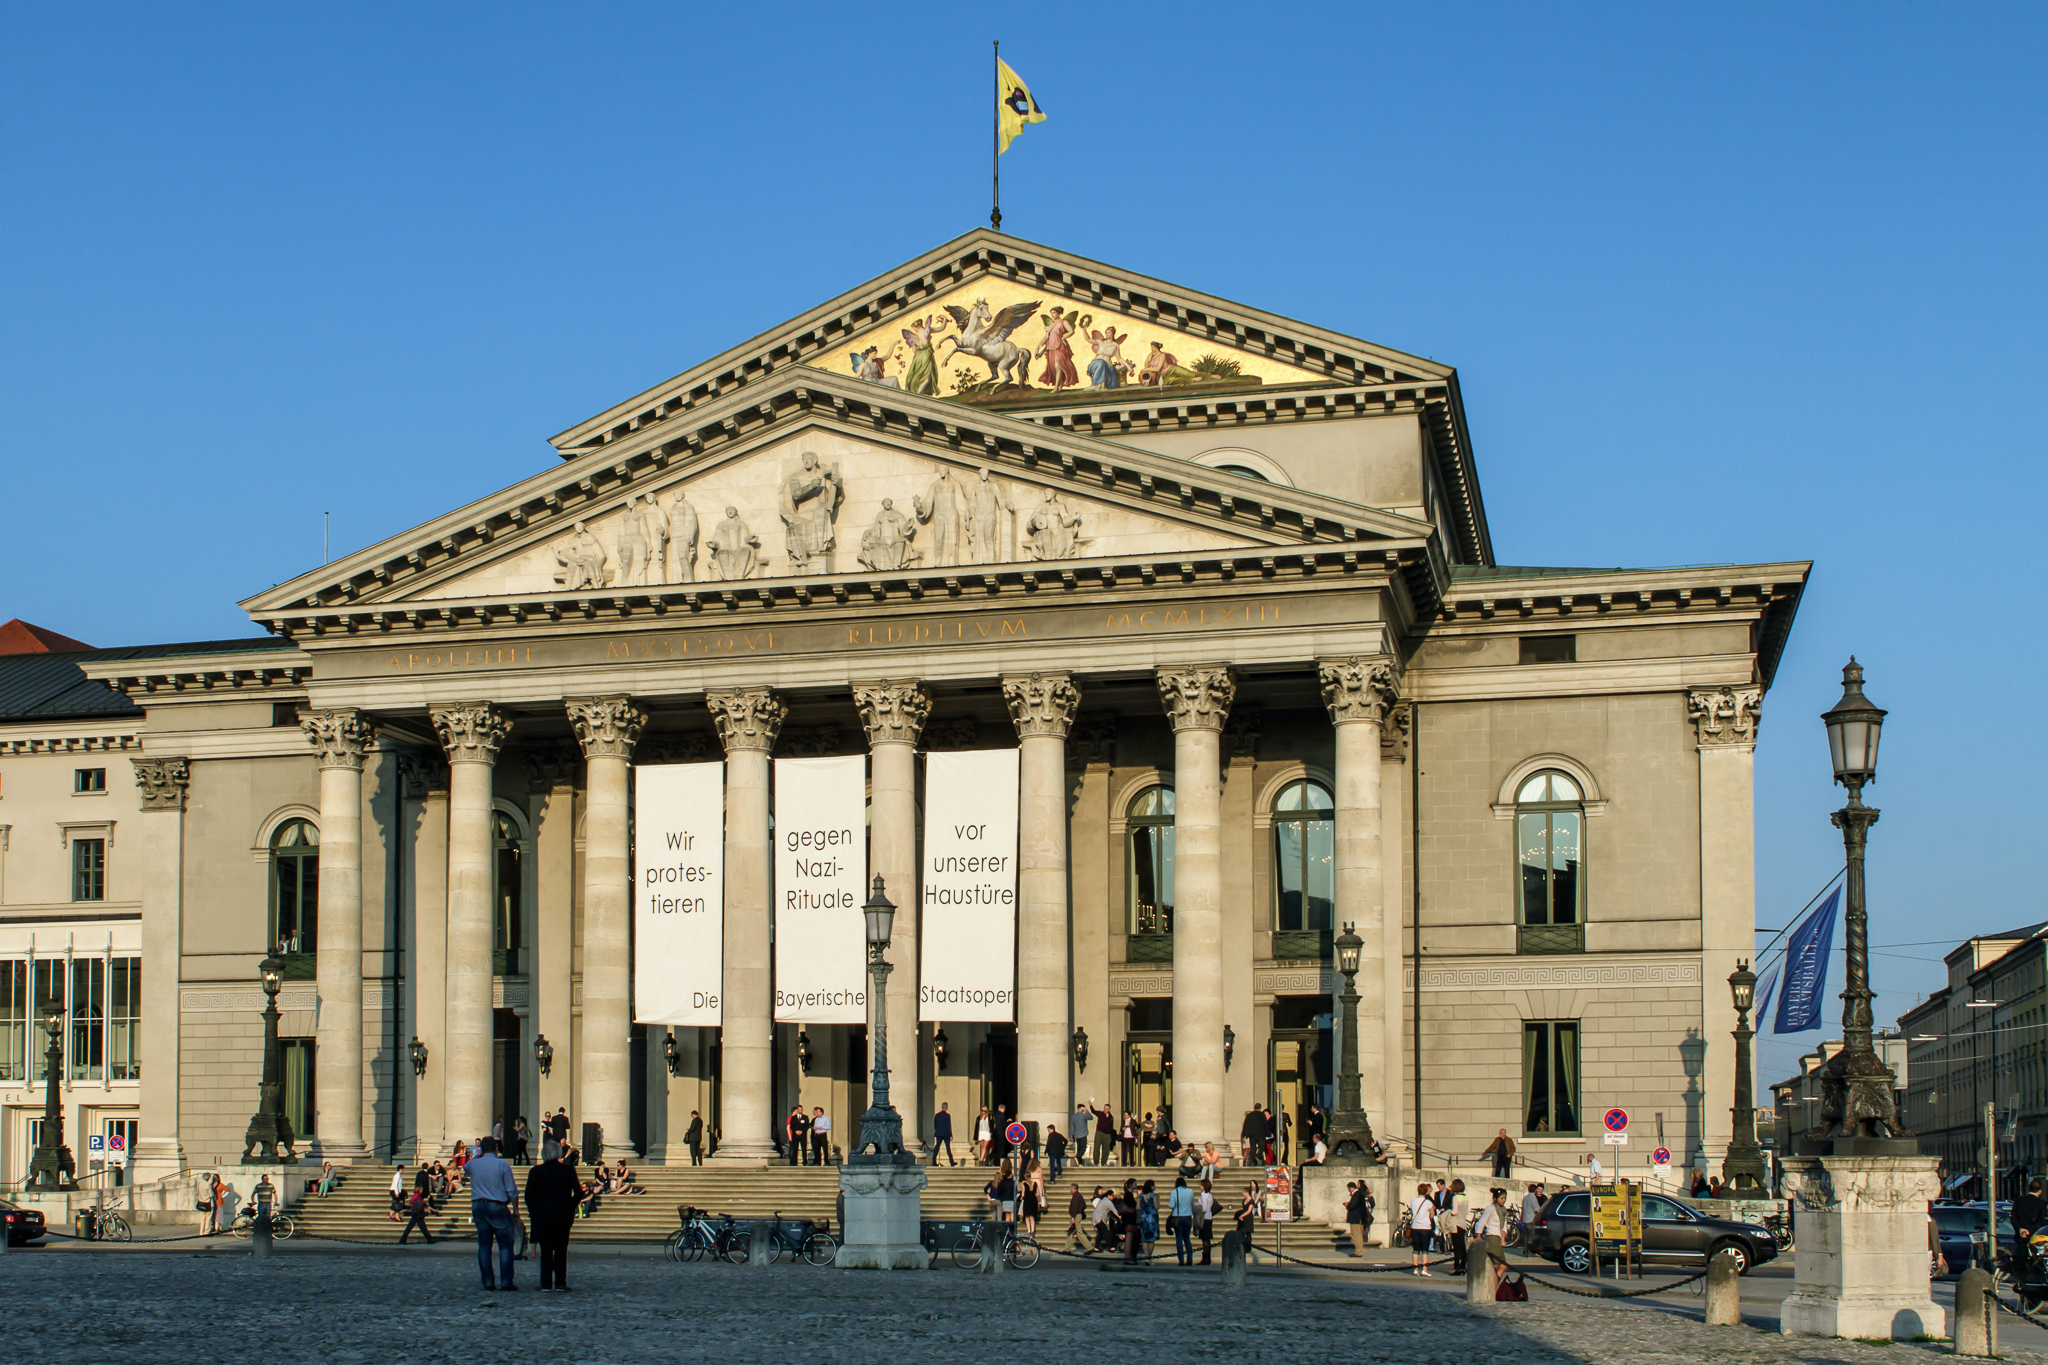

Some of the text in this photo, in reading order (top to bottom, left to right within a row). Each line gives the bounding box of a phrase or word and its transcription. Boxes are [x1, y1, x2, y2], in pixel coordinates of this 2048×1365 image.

[387, 604, 1279, 670] APOLLINI MVSISQVE REDDITVM MCMLXIII
[666, 831, 695, 851] Wir
[787, 829, 852, 852] gegen
[954, 824, 987, 841] vor
[646, 862, 713, 888] protes-
[796, 856, 844, 878] Nazi-
[934, 856, 1008, 873] unserer
[651, 894, 705, 914] tieren
[787, 888, 854, 910] Rituale
[925, 883, 1014, 905] Haustüre
[693, 992, 719, 1009] Die
[776, 988, 866, 1010] Bayerische
[921, 985, 1014, 1008] Staatsoper
[91, 1136, 101, 1149] P
[1592, 1186, 1616, 1194] EUROPA
